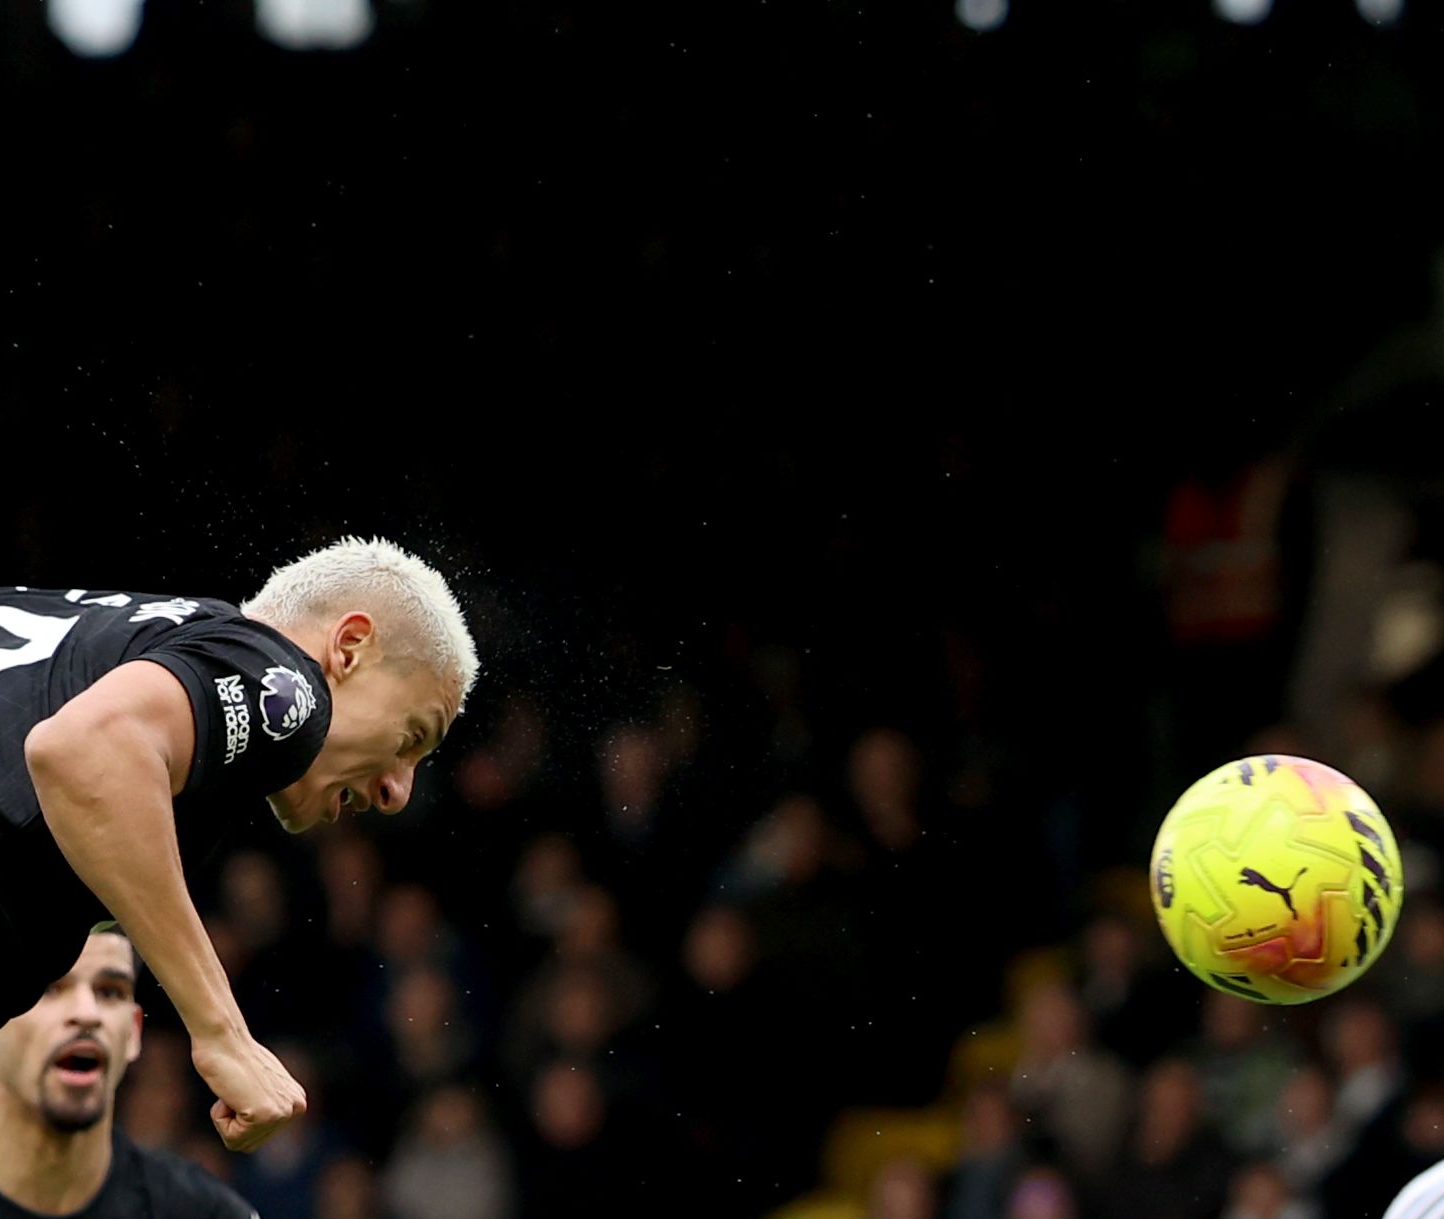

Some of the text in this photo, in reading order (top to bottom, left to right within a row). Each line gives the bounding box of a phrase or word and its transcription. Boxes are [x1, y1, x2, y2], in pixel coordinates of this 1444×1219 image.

[214, 678, 239, 765] for racism
[224, 674, 251, 754] No room
